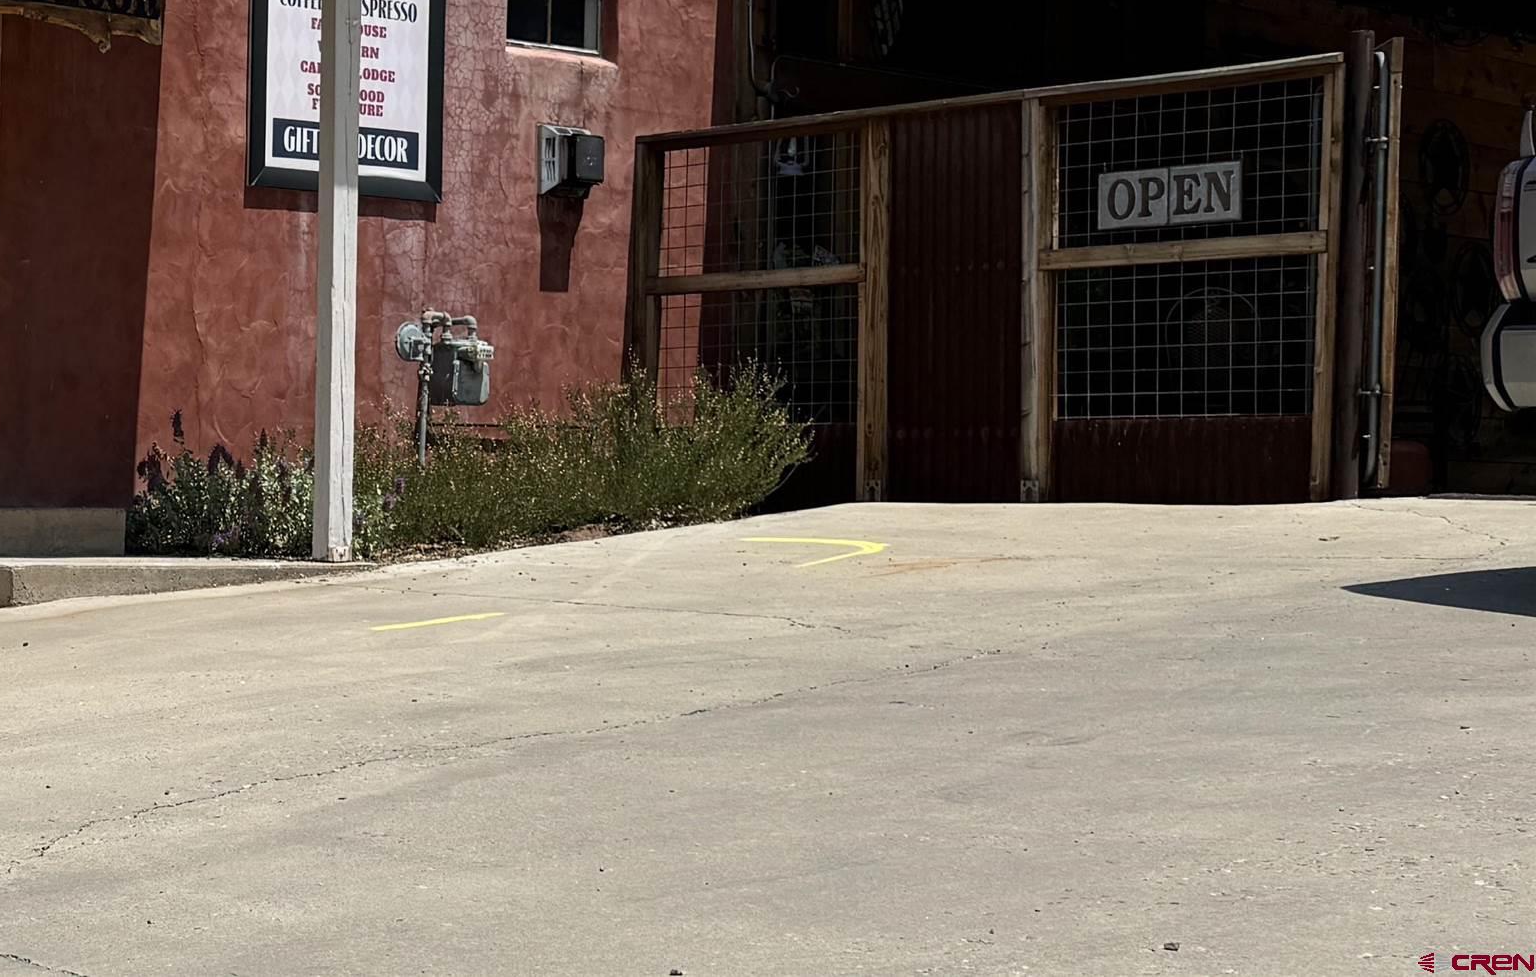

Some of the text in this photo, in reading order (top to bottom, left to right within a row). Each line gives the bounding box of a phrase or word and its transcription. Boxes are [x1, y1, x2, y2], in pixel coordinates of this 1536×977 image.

[360, 68, 395, 83] ODGE
[284, 126, 321, 154] GIFT
[1107, 170, 1234, 220] OPEN
